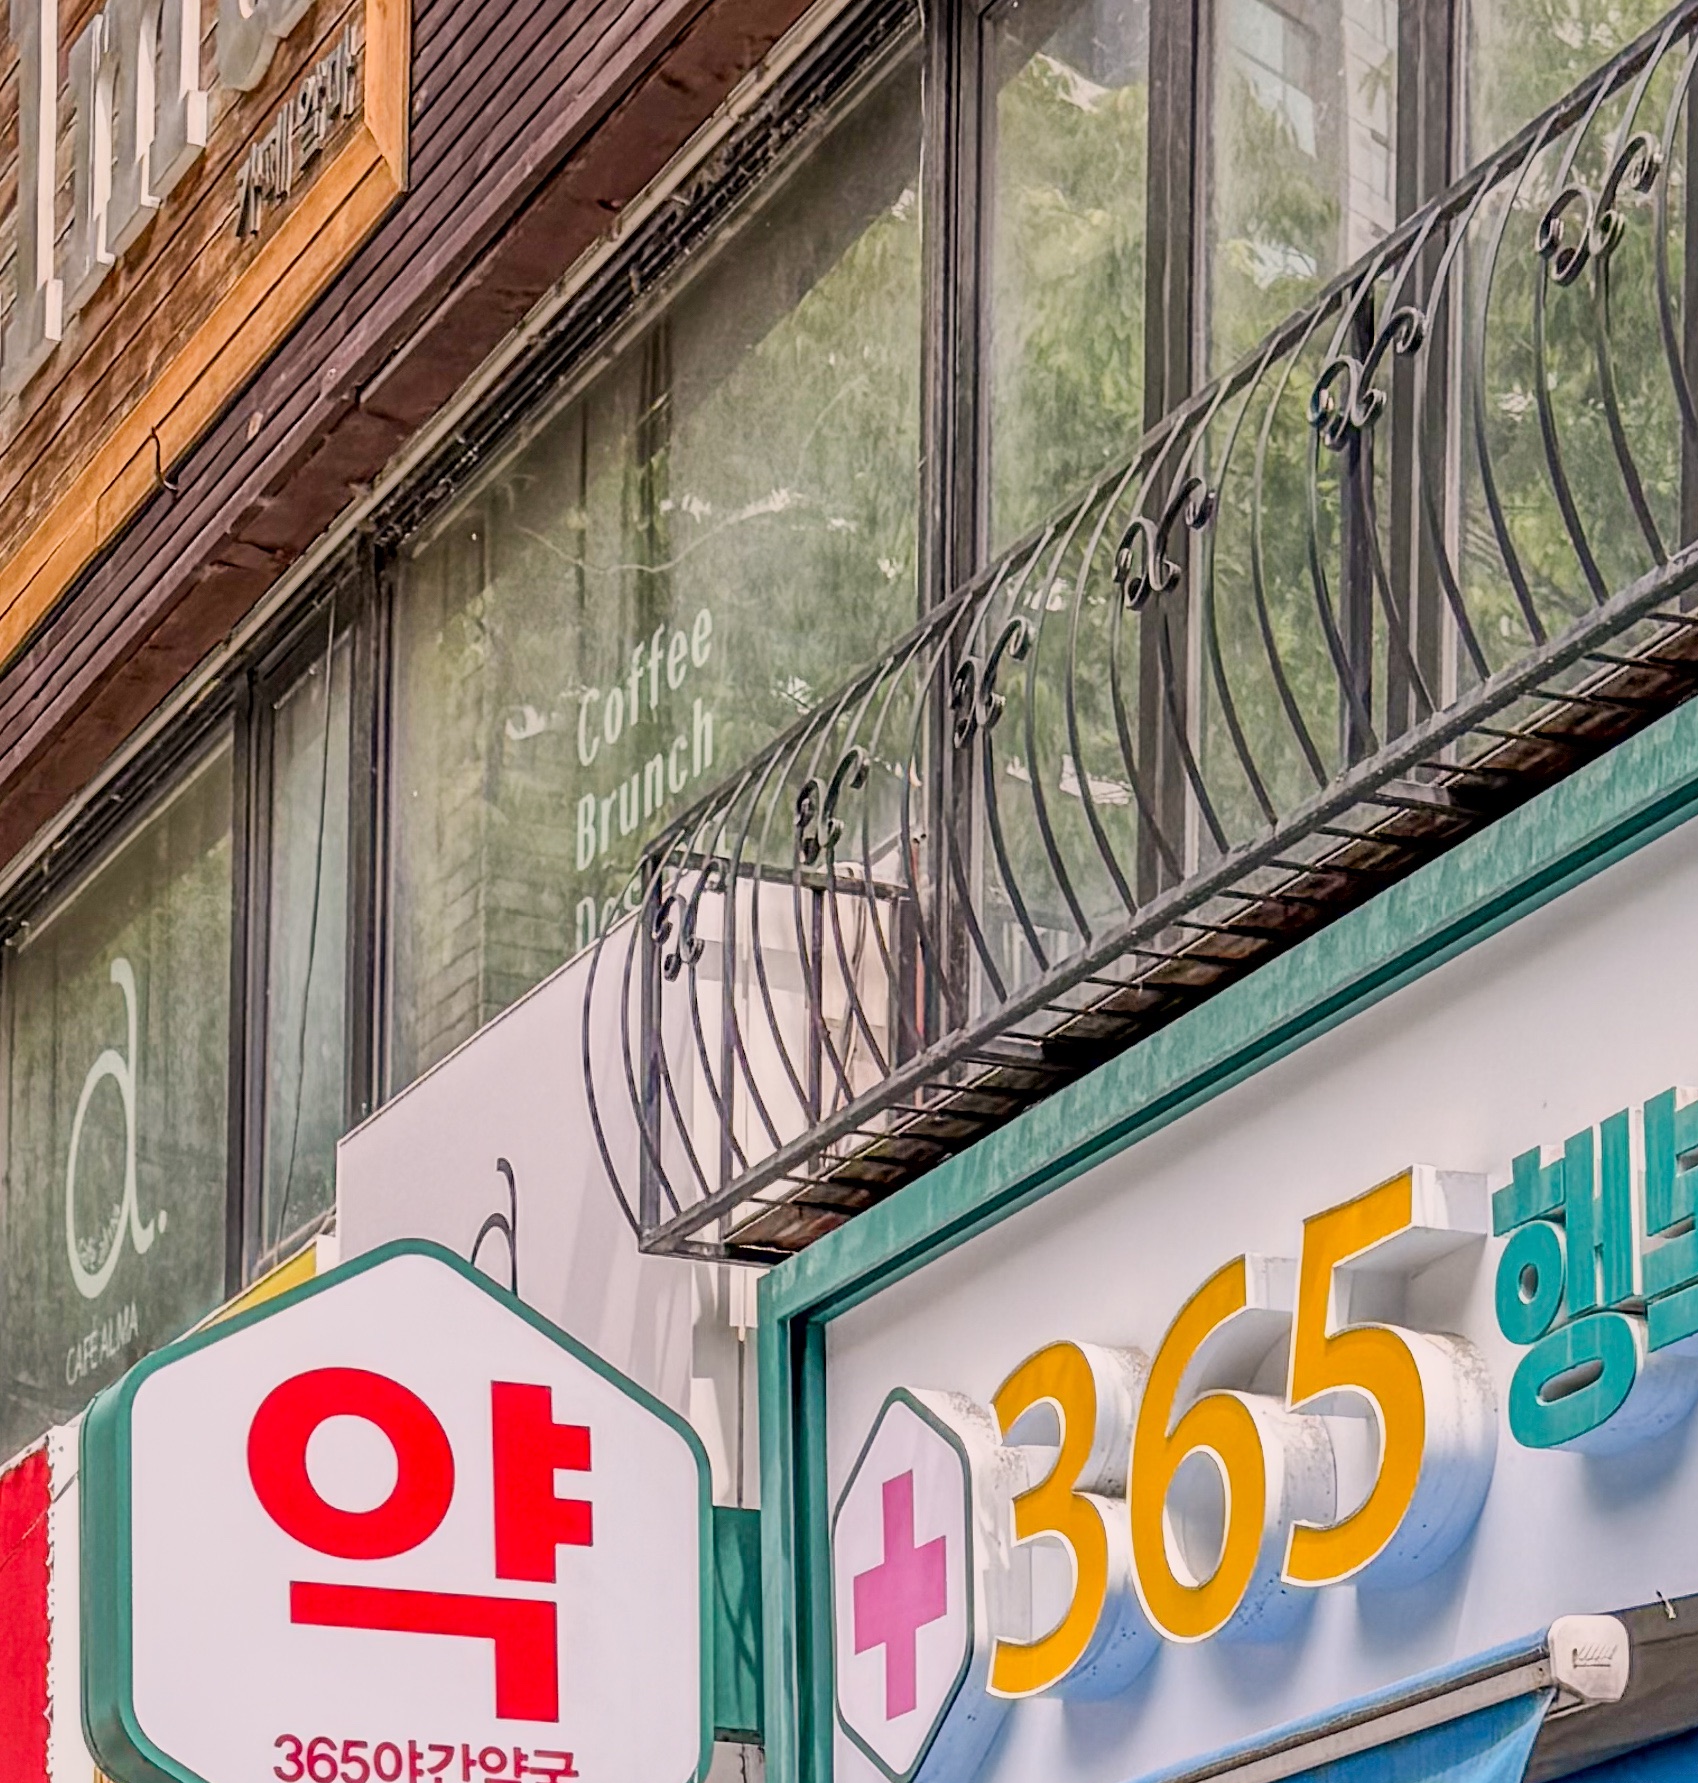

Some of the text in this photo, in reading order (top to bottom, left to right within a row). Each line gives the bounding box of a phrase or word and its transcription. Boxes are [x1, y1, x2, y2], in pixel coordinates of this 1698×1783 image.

[576, 697, 714, 872] Brunch
[577, 607, 713, 767] Coffee
[246, 1366, 593, 1723] 약
[984, 1164, 1435, 1700] 365
